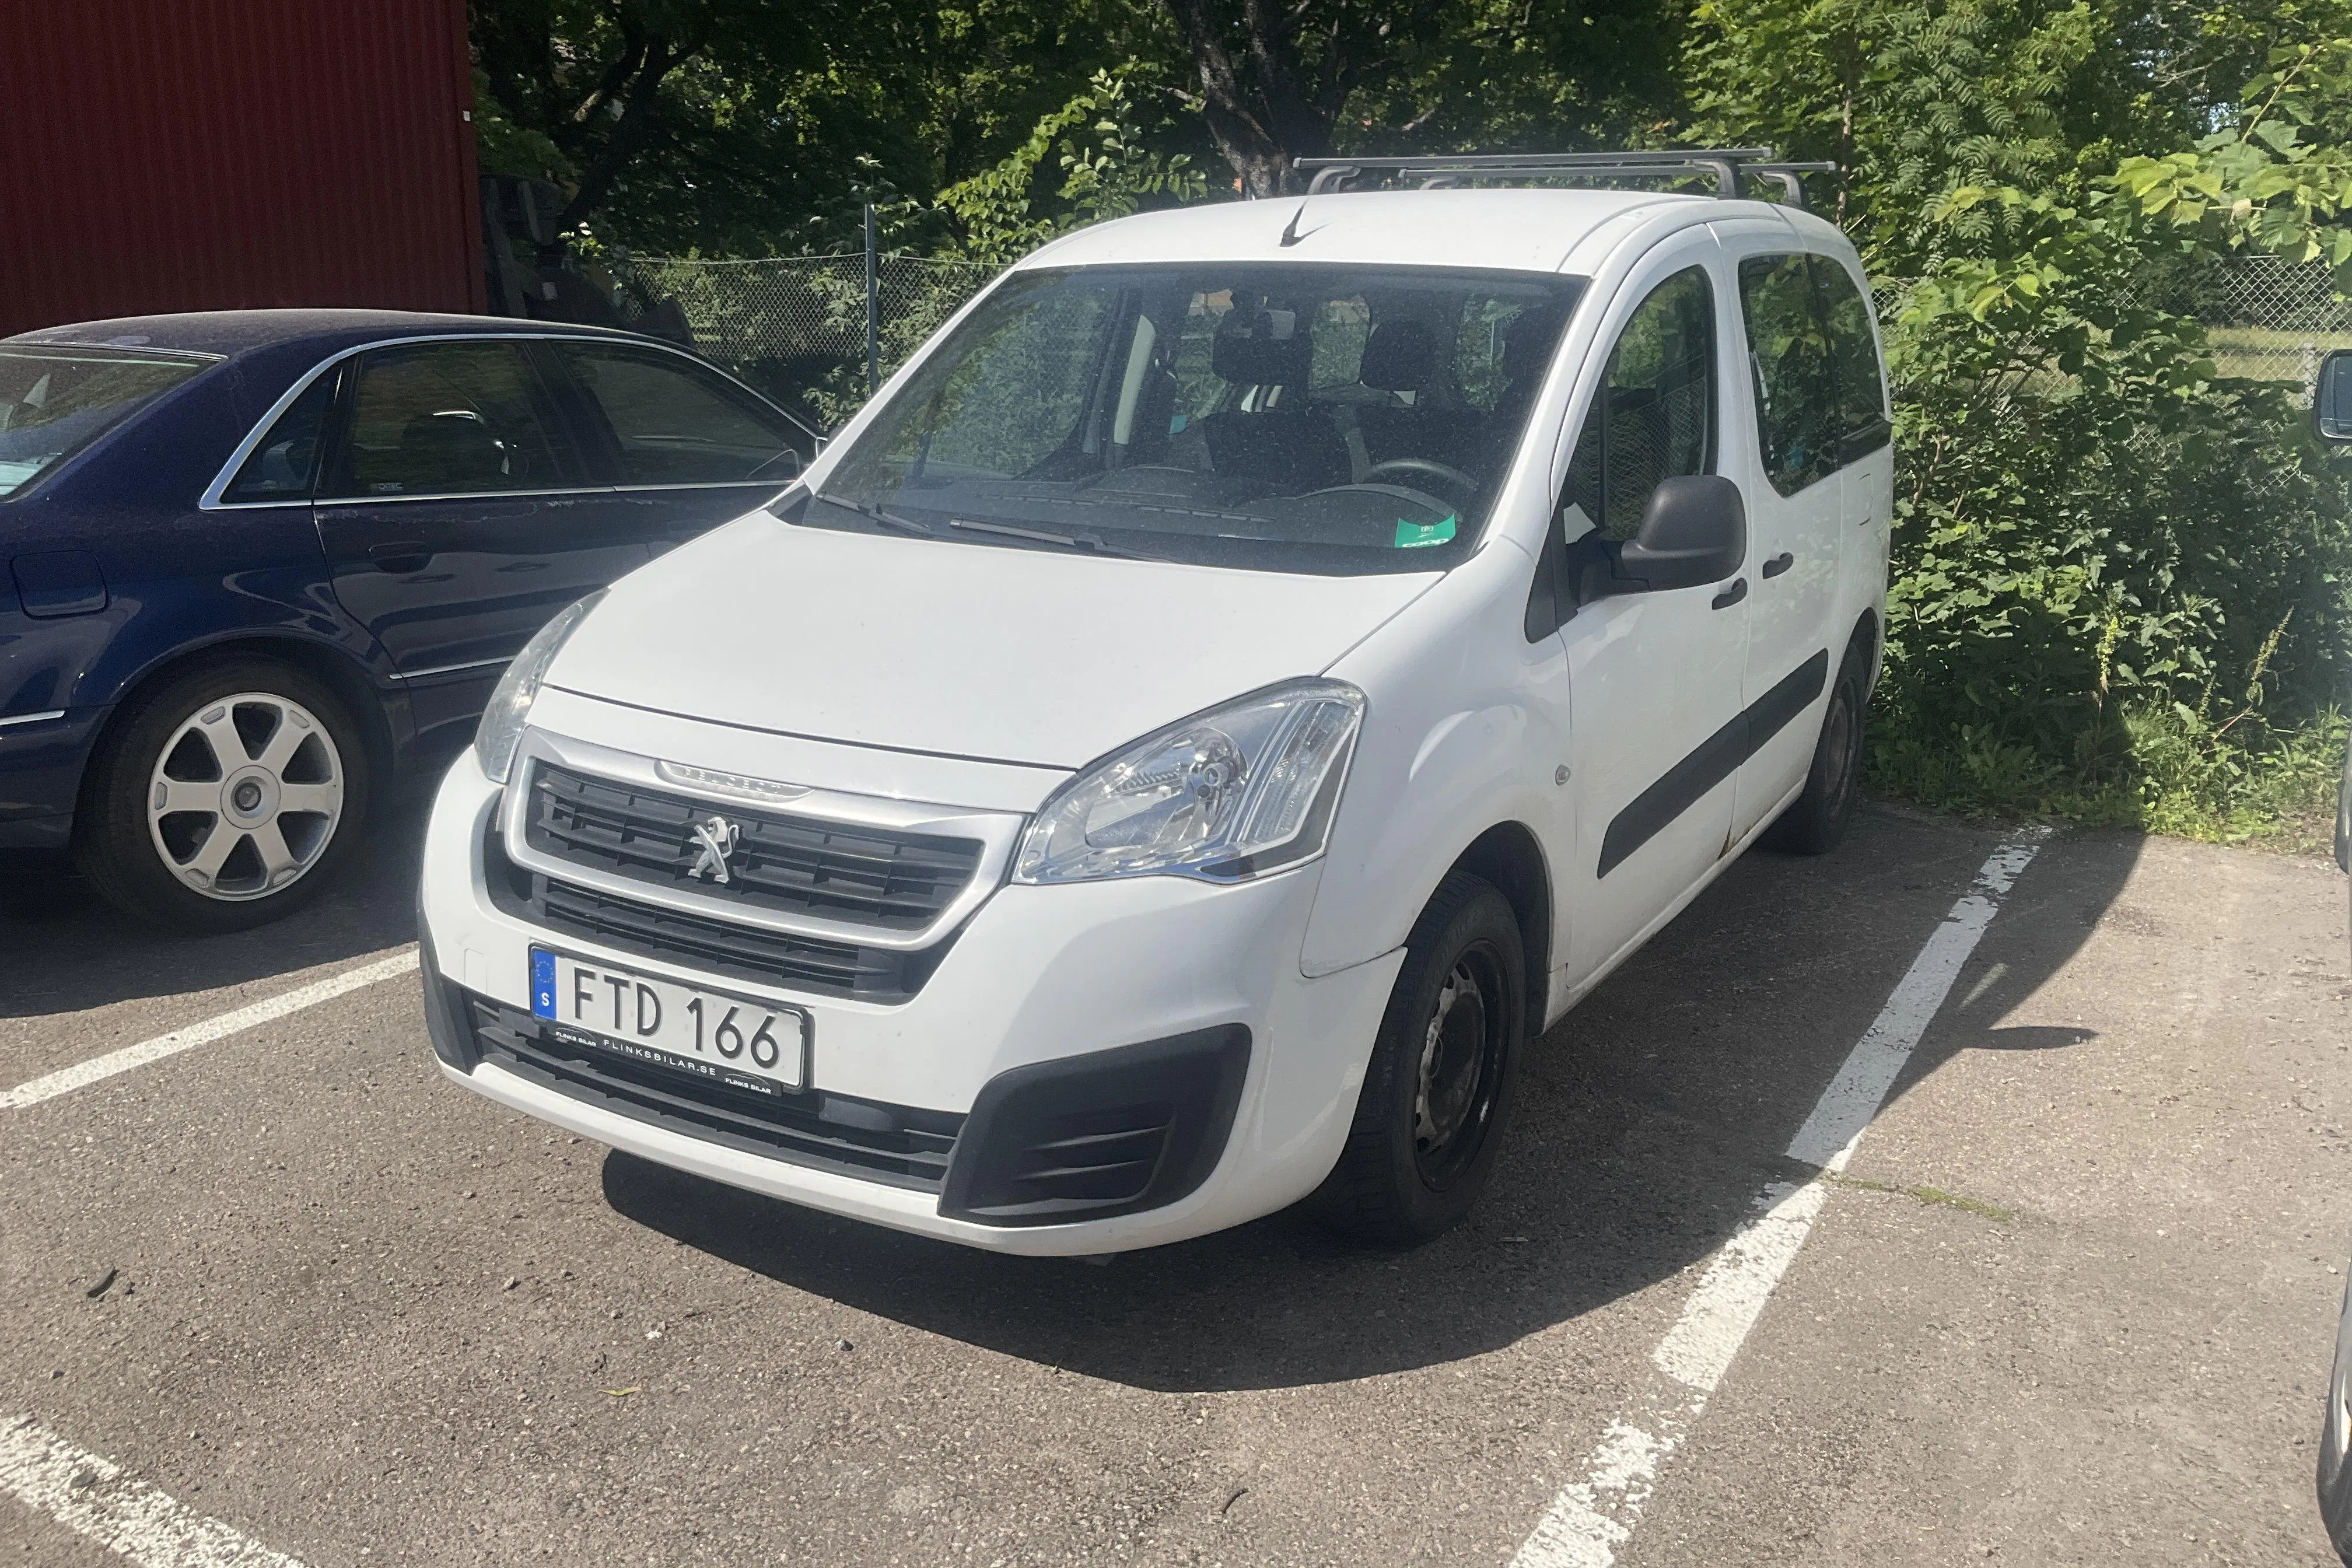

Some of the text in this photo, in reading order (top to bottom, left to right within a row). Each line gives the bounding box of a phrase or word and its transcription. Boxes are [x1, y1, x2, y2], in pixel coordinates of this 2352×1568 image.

[541, 992, 550, 1006] S
[574, 967, 779, 1068] FTD 166
[556, 1031, 596, 1047] FLINKS BILAR
[604, 1039, 716, 1076] FLINKSBILAR.SE
[725, 1077, 771, 1094] FLINKS BILAR
